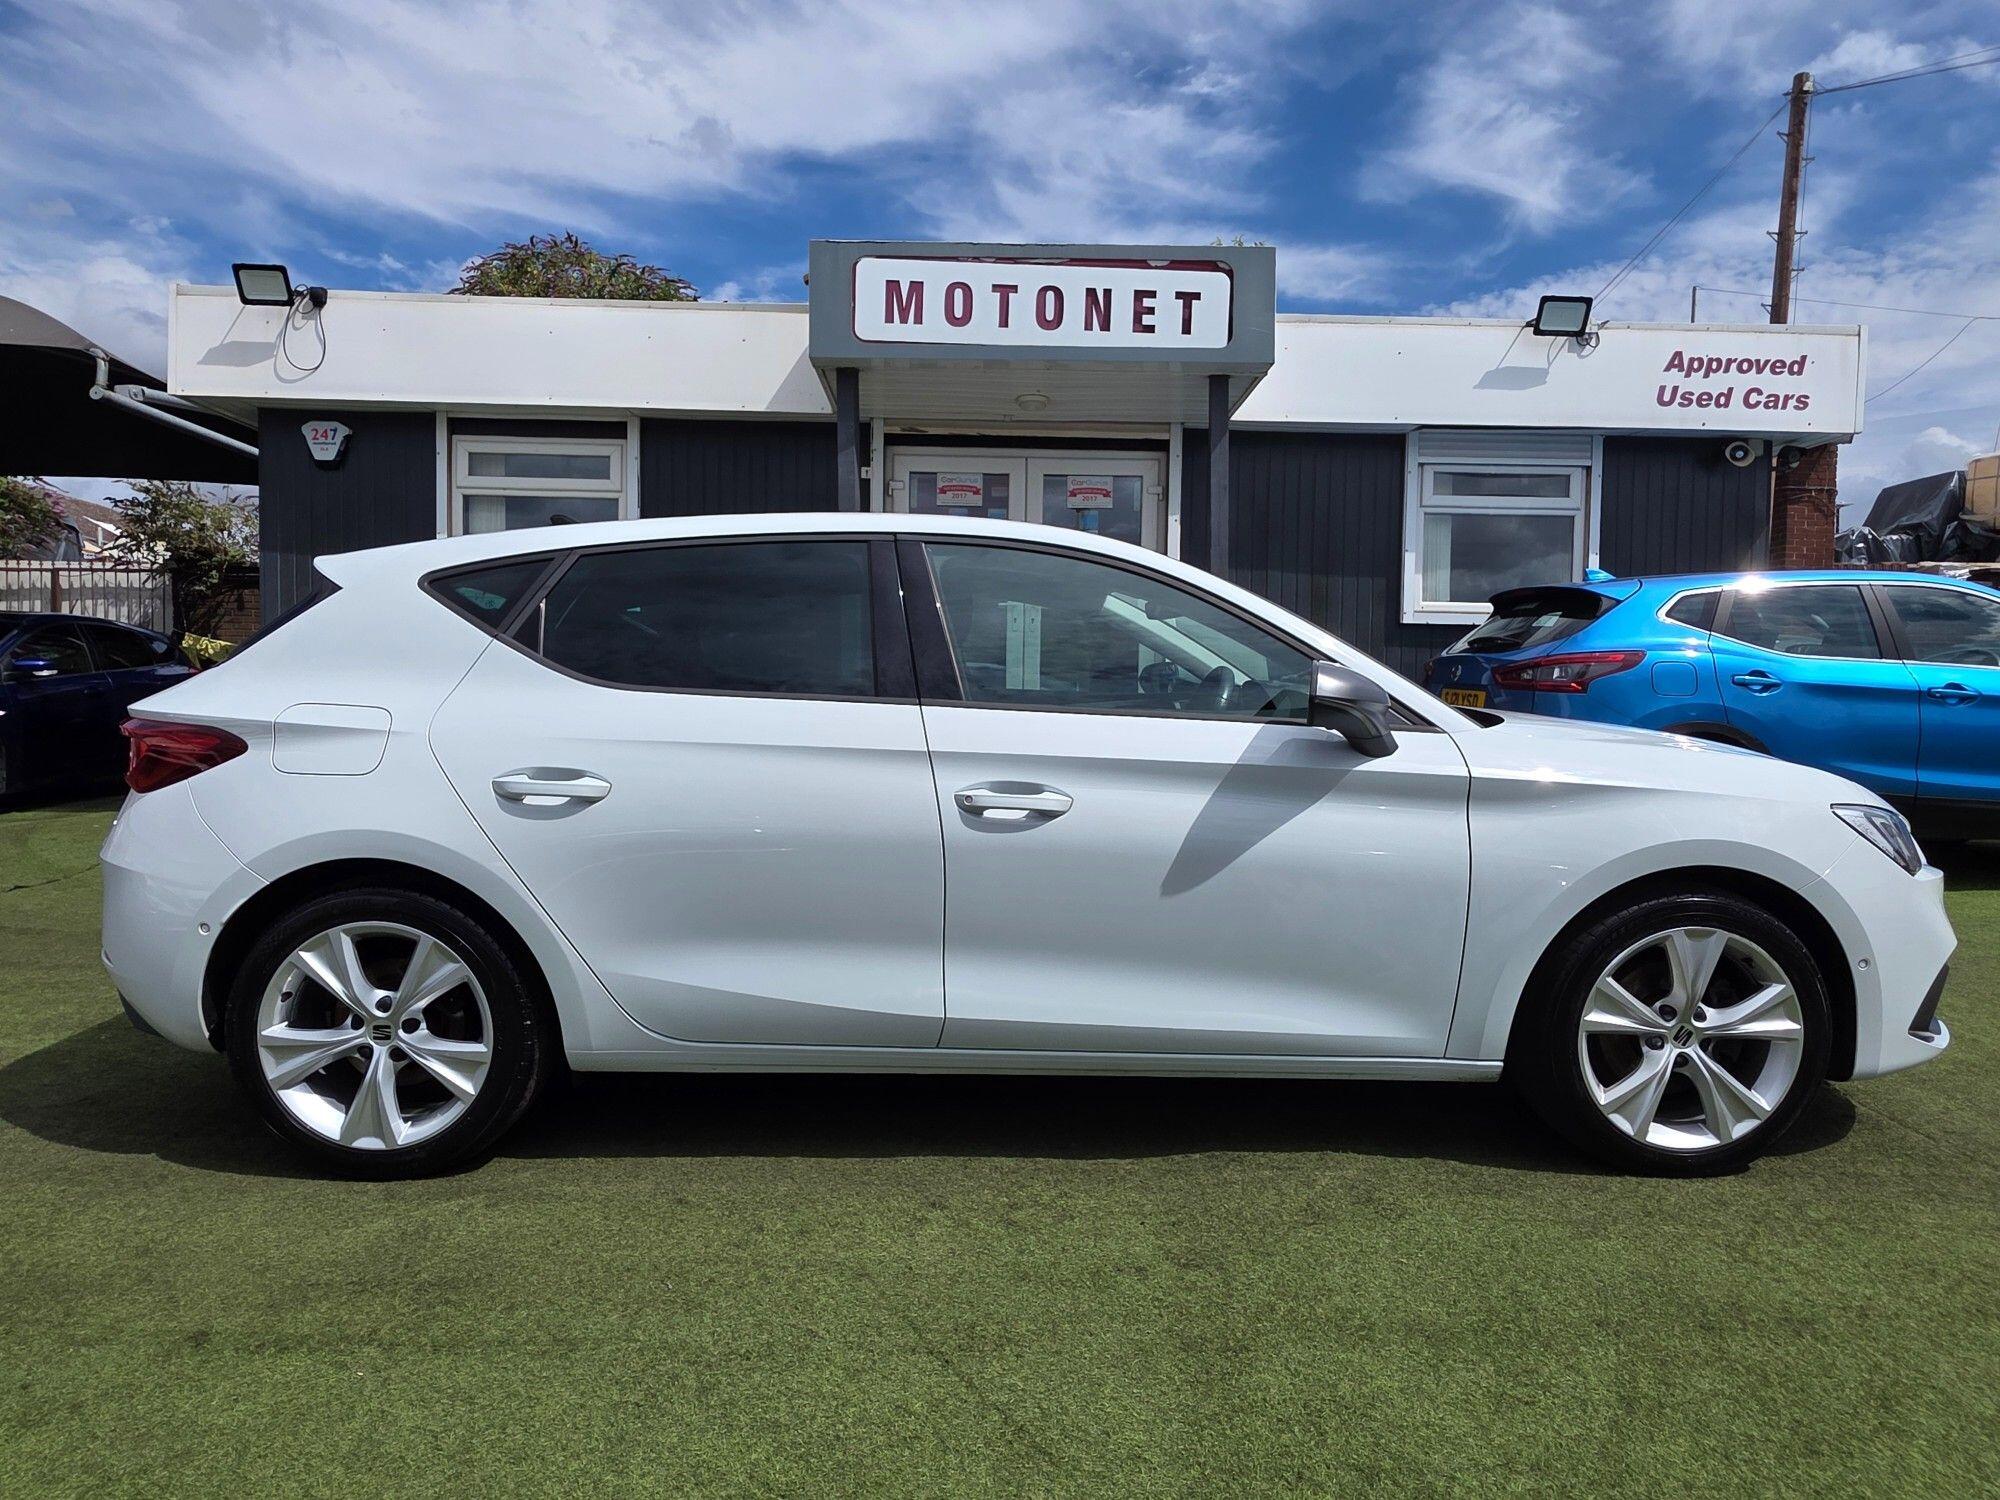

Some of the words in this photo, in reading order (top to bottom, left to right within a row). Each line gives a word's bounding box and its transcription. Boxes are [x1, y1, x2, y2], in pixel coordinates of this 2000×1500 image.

[884, 279, 1202, 336] MOTONET
[1662, 350, 1808, 379] Approved
[1655, 384, 1734, 409] Used
[1742, 386, 1810, 411] Cars
[310, 427, 338, 441] 247
[951, 492, 968, 500] 2017
